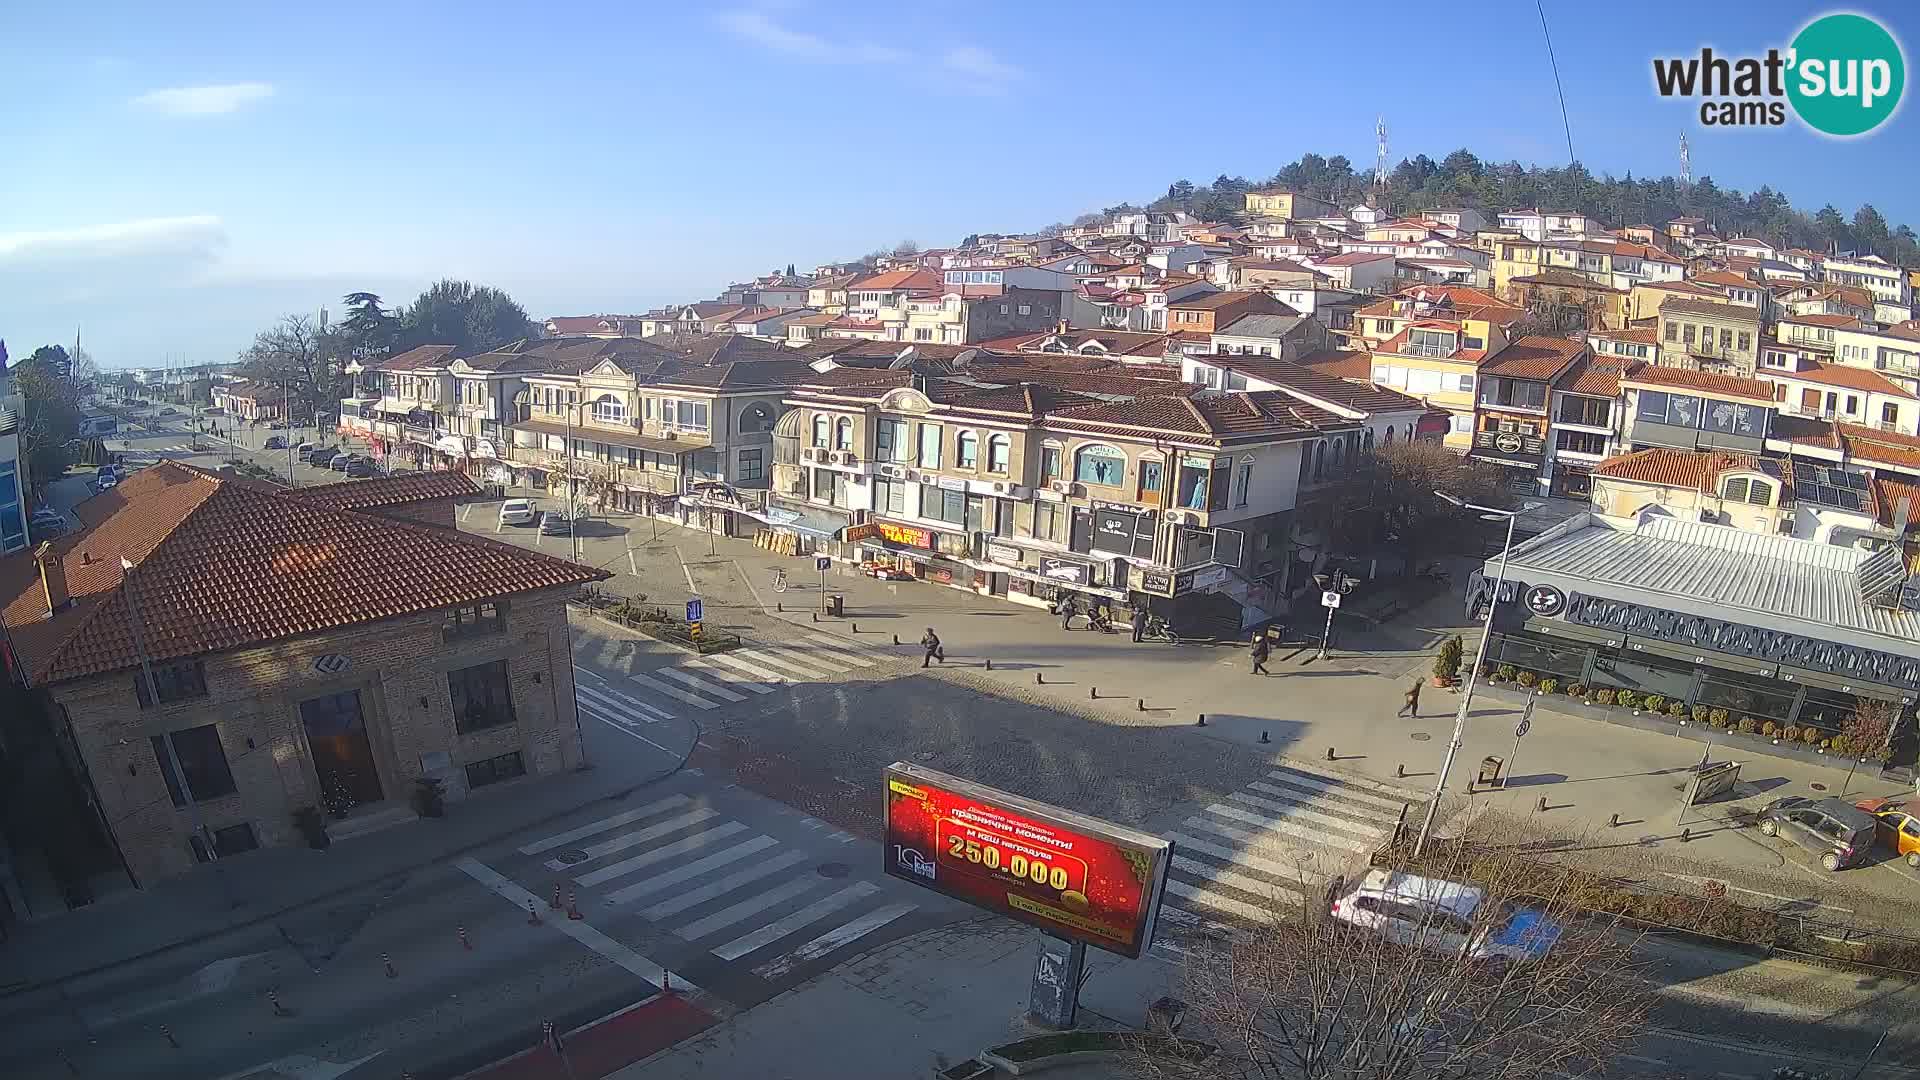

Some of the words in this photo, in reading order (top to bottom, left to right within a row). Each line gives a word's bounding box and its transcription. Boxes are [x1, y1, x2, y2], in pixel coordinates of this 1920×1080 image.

[820, 559, 828, 569] P
[951, 808, 1013, 832] празнични
[1015, 828, 1073, 850] моменти!
[948, 835, 1068, 890] 250.000
[1001, 841, 1053, 861] наградува
